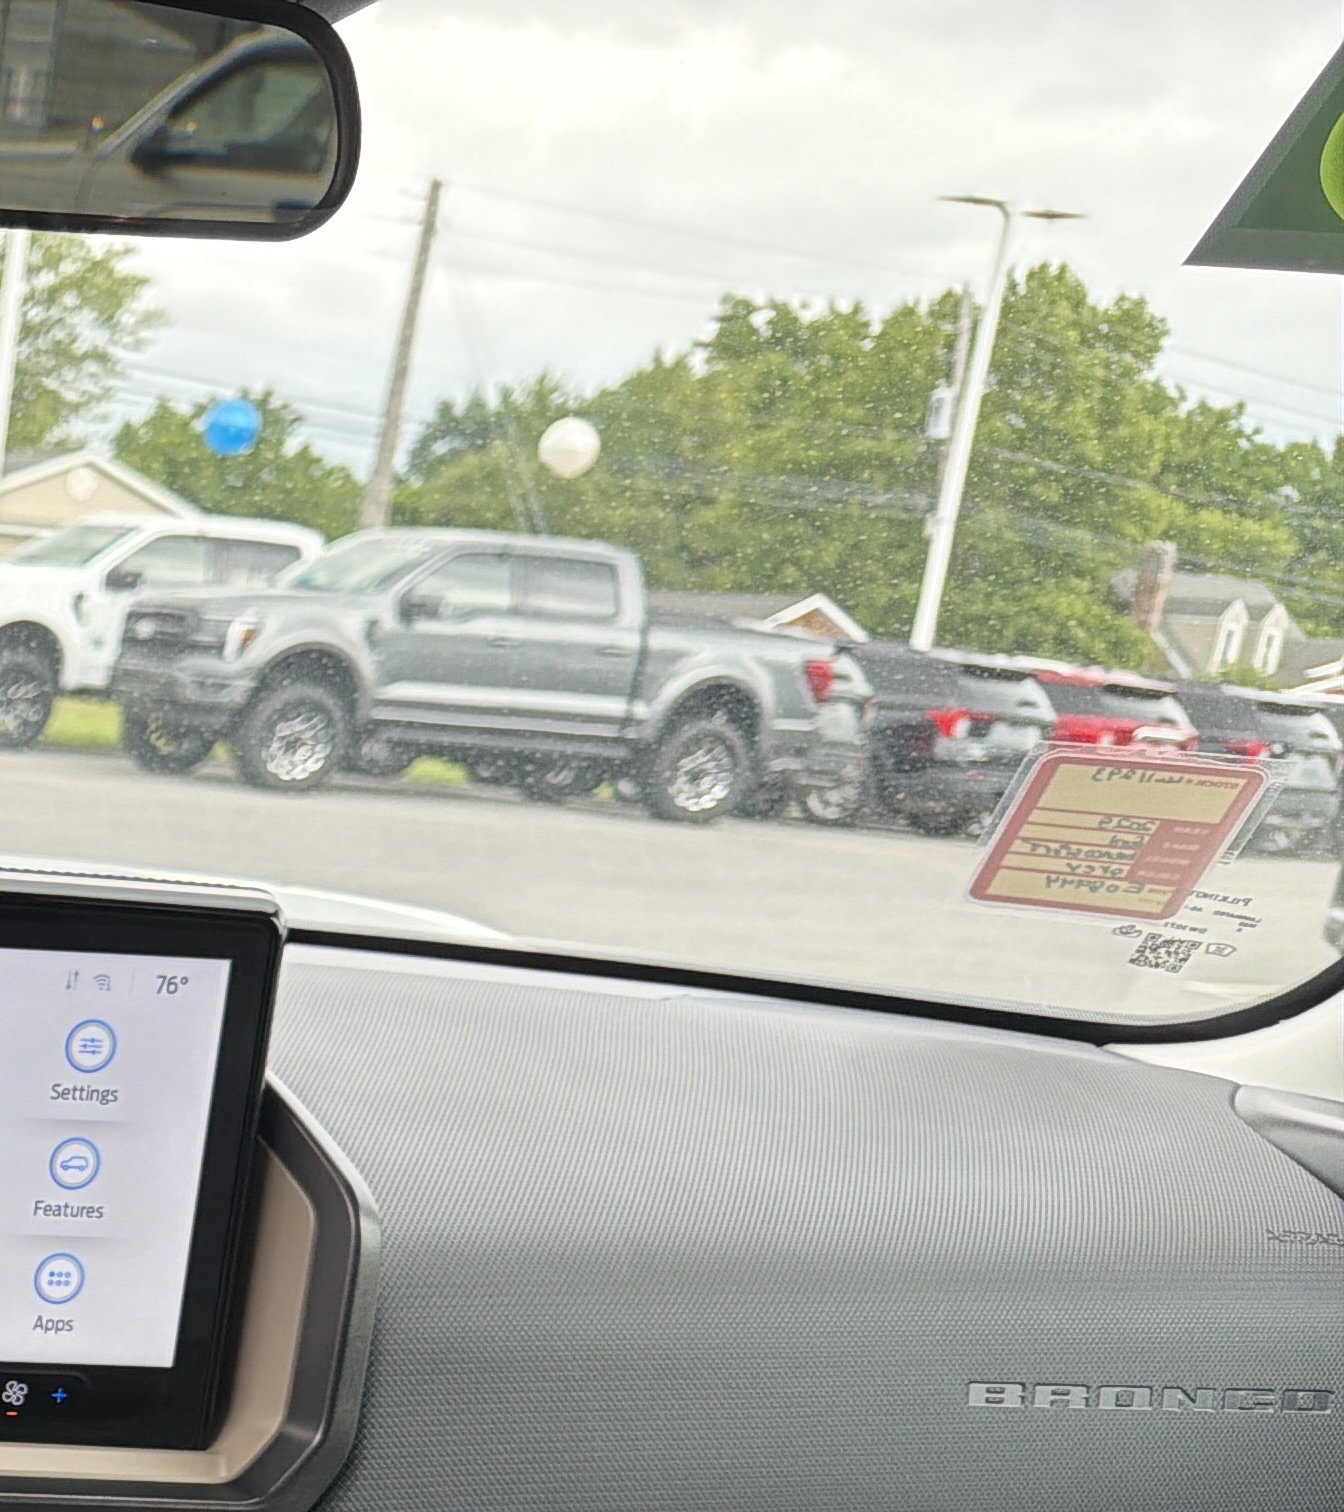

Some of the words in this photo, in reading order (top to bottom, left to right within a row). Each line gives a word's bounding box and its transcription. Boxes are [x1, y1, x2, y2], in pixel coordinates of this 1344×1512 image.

[155, 974, 190, 995] 76°
[49, 1083, 119, 1106] Settings
[32, 1199, 105, 1220] Features
[32, 1314, 74, 1335] Apps
[967, 1380, 1335, 1414] BRONCO
